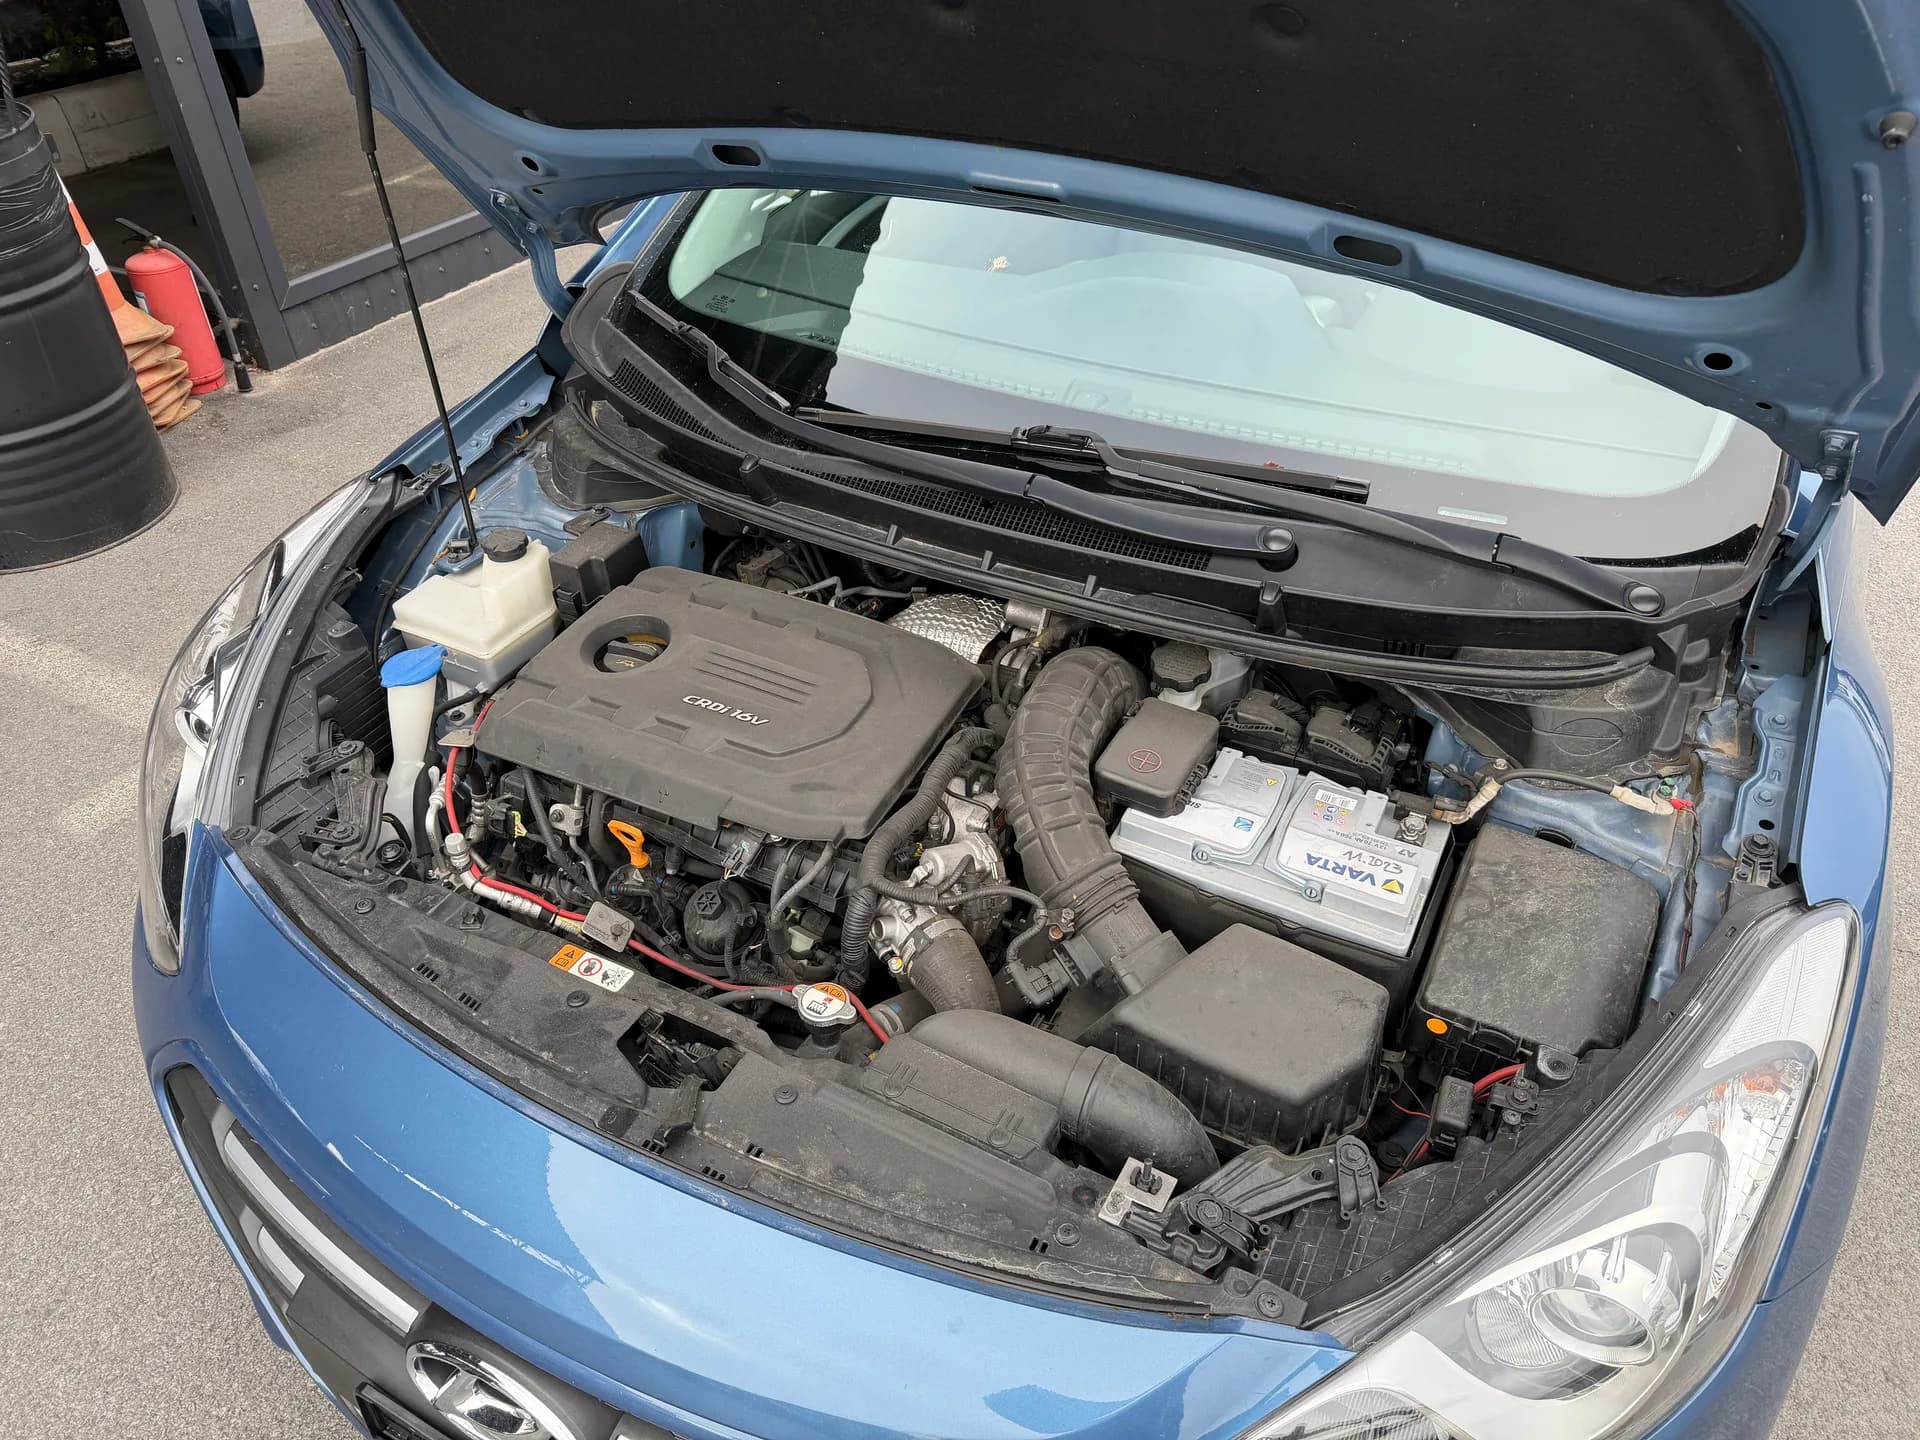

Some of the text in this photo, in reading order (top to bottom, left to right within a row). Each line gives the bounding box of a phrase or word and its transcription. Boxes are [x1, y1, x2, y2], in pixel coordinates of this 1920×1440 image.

[682, 695, 770, 725] CRDi 16V
[1398, 848, 1417, 858] A7
[1306, 852, 1376, 887] VARTA
